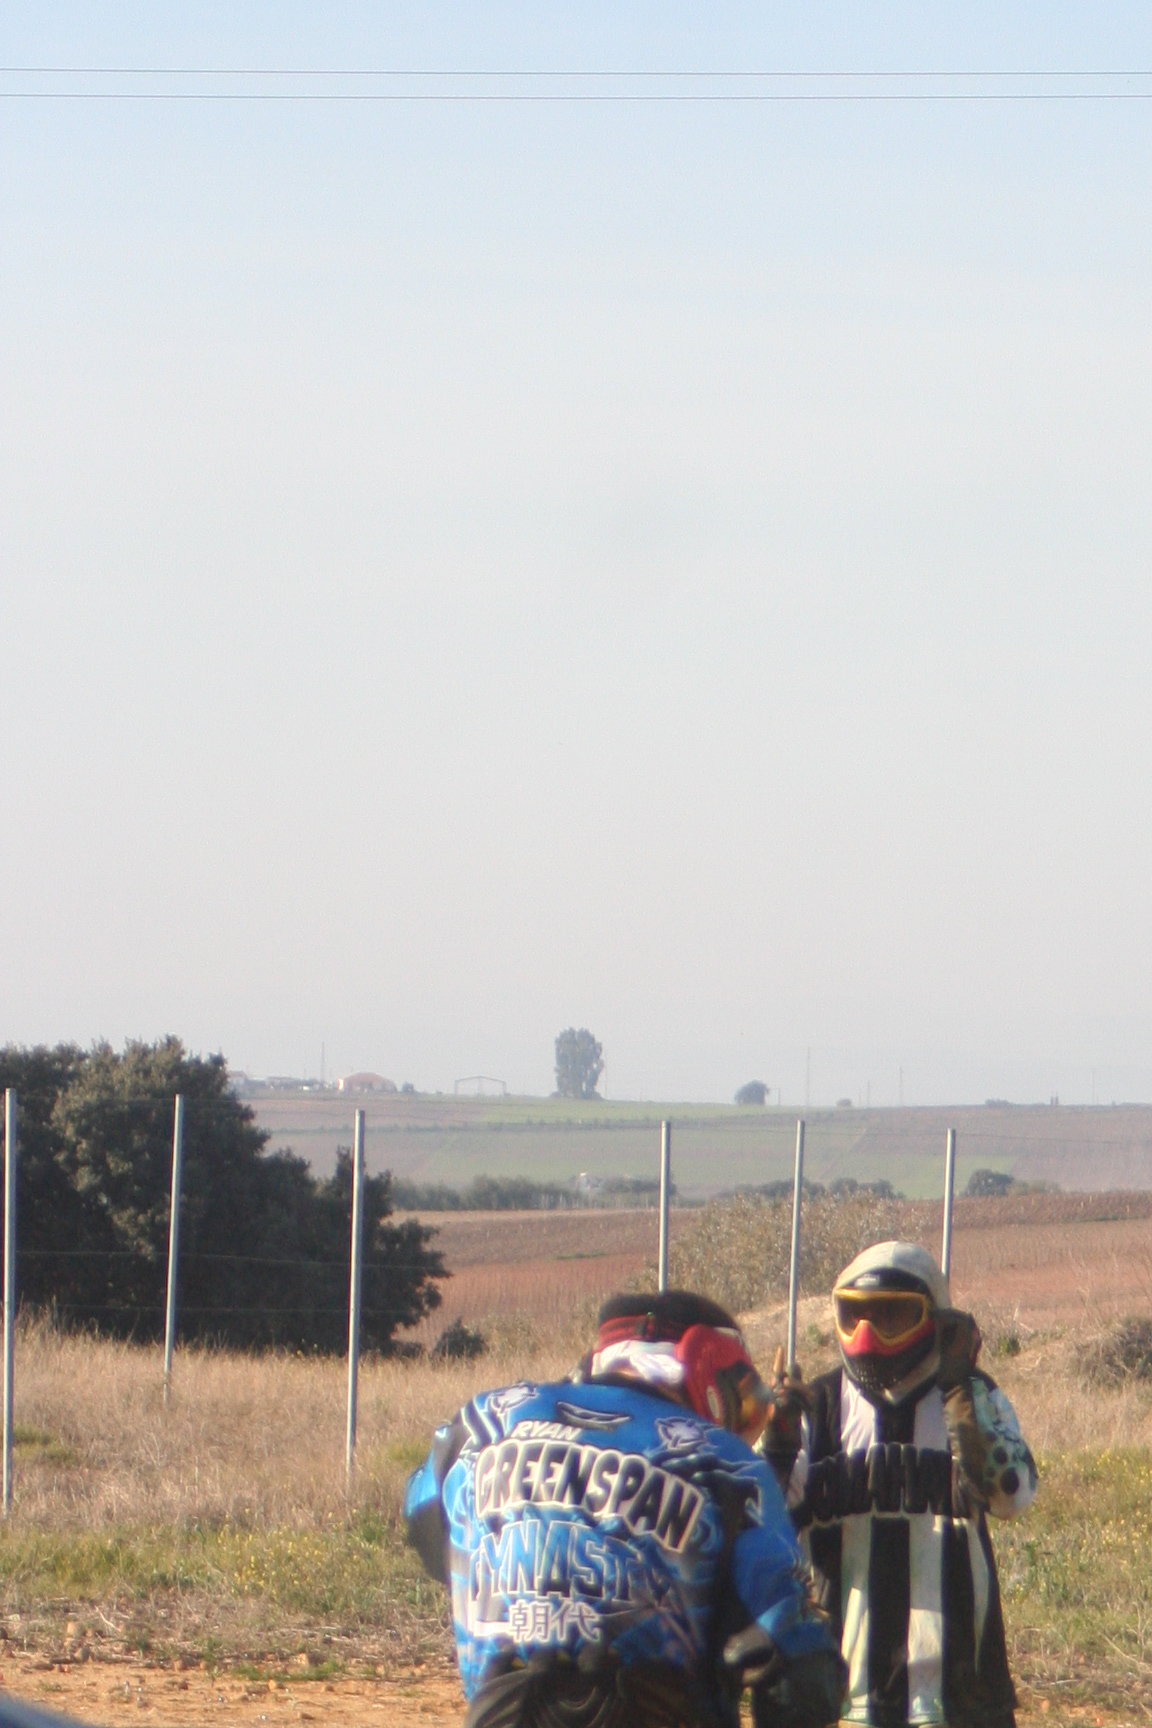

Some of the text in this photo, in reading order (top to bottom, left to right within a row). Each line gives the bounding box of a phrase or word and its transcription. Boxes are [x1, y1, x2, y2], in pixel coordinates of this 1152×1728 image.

[510, 1420, 583, 1442] RYAN
[475, 1439, 703, 1554] GREENSPAN
[508, 1599, 601, 1643] 朝代
